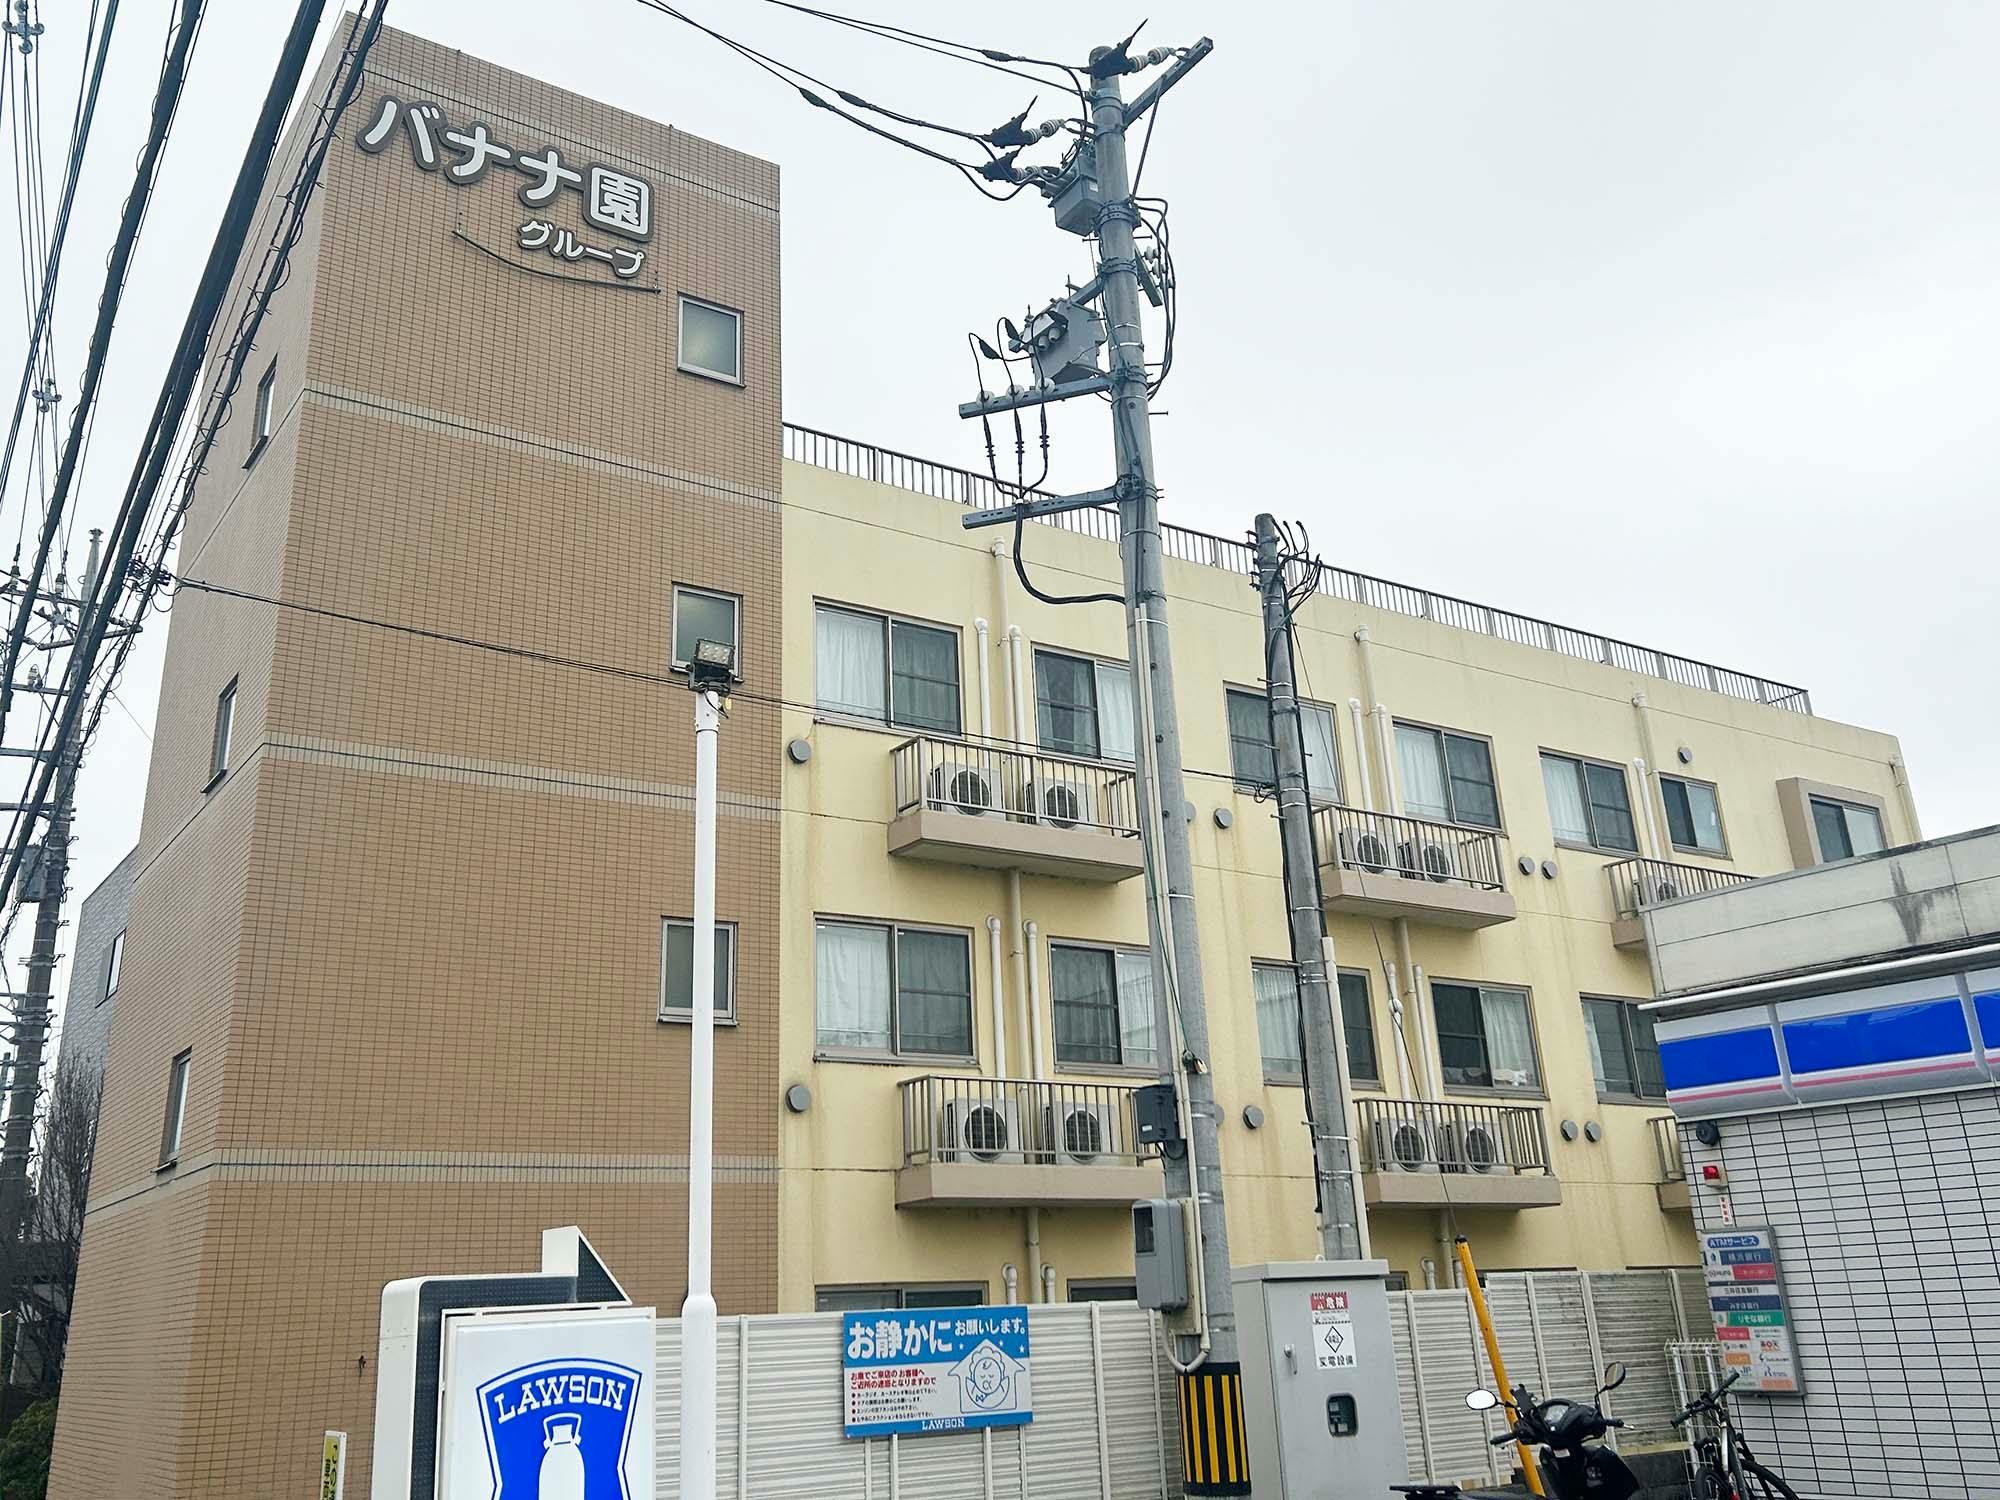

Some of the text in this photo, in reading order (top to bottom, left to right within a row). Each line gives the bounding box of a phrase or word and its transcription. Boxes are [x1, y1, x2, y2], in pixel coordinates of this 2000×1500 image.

[361, 97, 652, 239] バナナ園
[519, 219, 646, 277] グループ
[1709, 1237, 1757, 1248] ATMサービス
[847, 1317, 1025, 1360] お静かに お願いします。
[493, 1374, 627, 1424] LAWSON
[922, 1417, 965, 1431] LAWSON
